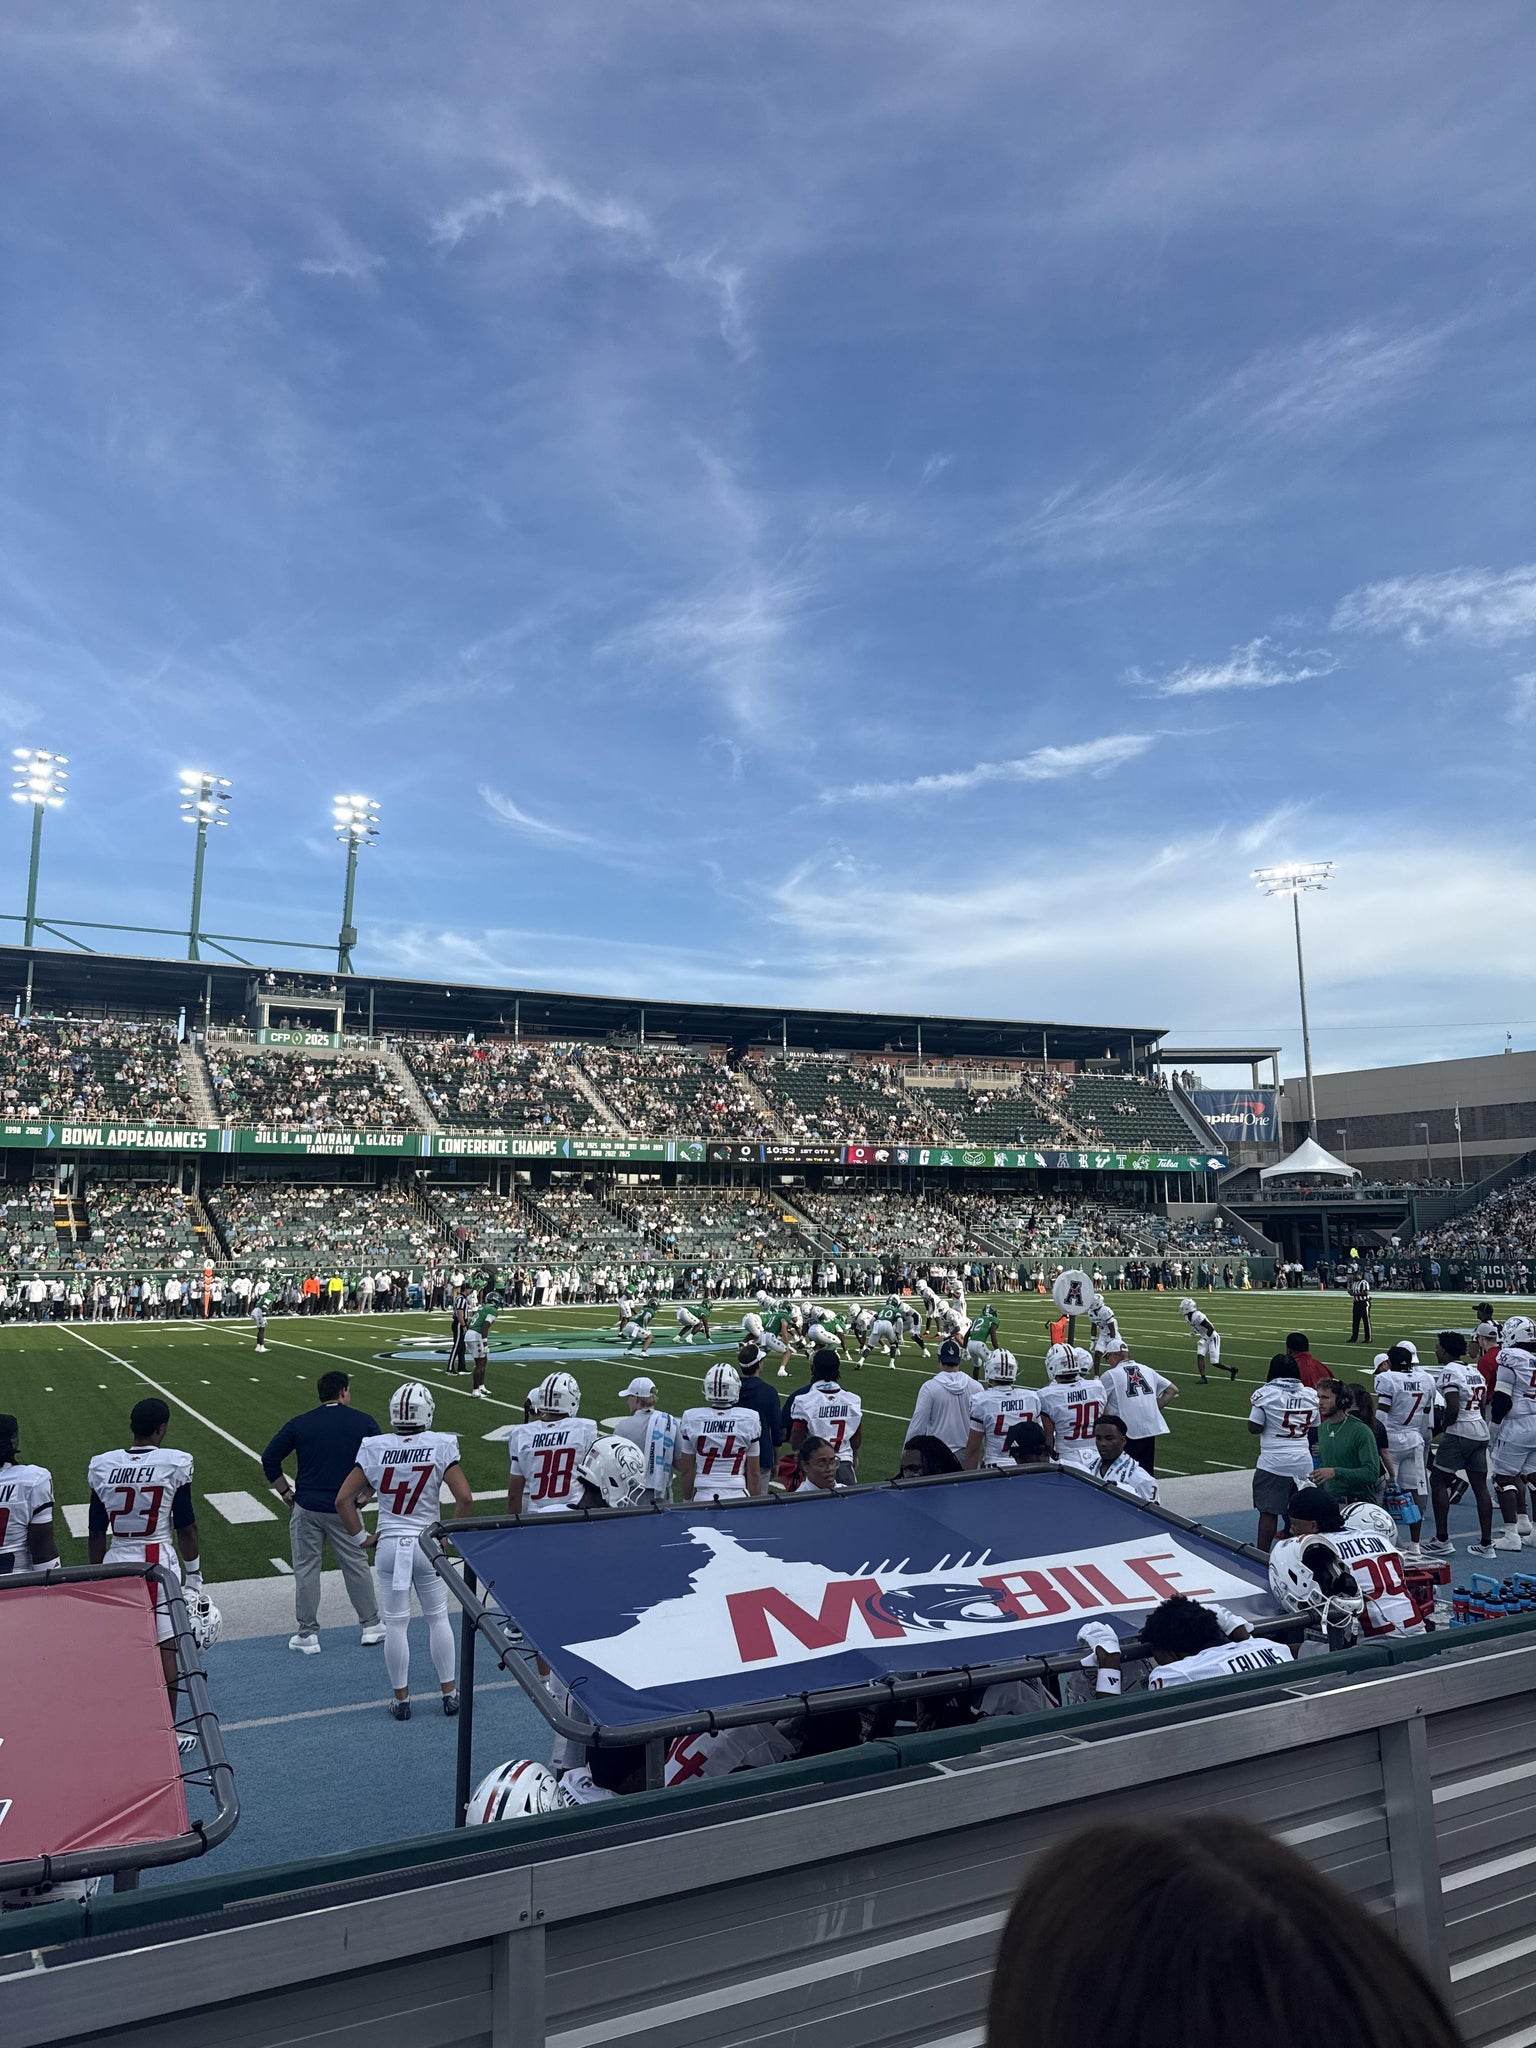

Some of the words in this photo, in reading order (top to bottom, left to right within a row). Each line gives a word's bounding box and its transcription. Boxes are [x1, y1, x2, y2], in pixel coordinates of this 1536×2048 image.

[270, 1033, 290, 1042] CFP
[304, 1033, 329, 1046] 2025
[61, 1128, 104, 1146] BOWL
[106, 1130, 207, 1149] APPEARANCES
[255, 1131, 278, 1144] JILL
[281, 1133, 292, 1144] H.
[294, 1135, 312, 1144] AND
[315, 1134, 351, 1145] AVRAM
[353, 1135, 364, 1146] A.
[366, 1135, 403, 1146] GLAZER
[306, 1145, 333, 1154] FAMILY
[335, 1145, 354, 1154] CLUB
[438, 1139, 508, 1154] CONFERENCE
[512, 1140, 557, 1155] CHAMPS
[741, 1146, 751, 1156] 0
[766, 1146, 796, 1154] 10:53
[855, 1148, 865, 1158] 0
[1157, 1158, 1179, 1168] Tulsa
[1403, 1381, 1422, 1392] VANCE
[1067, 1389, 1088, 1403] HAND
[819, 1405, 840, 1418] WEBB
[1001, 1399, 1024, 1412] PORCO
[1402, 1392, 1424, 1426] 7
[703, 1419, 736, 1434] TURNER
[1064, 1401, 1101, 1441] 30
[532, 1430, 571, 1449] ARGENT
[829, 1419, 846, 1452] 3
[381, 1447, 434, 1465] ROUNTREE
[697, 1435, 747, 1476] 44
[108, 1467, 155, 1484] GURLEY
[530, 1448, 576, 1500] 38
[379, 1464, 435, 1515] 47
[109, 1486, 164, 1537] 23
[1337, 1537, 1387, 1560] JACKSON
[1351, 1552, 1425, 1638] 29
